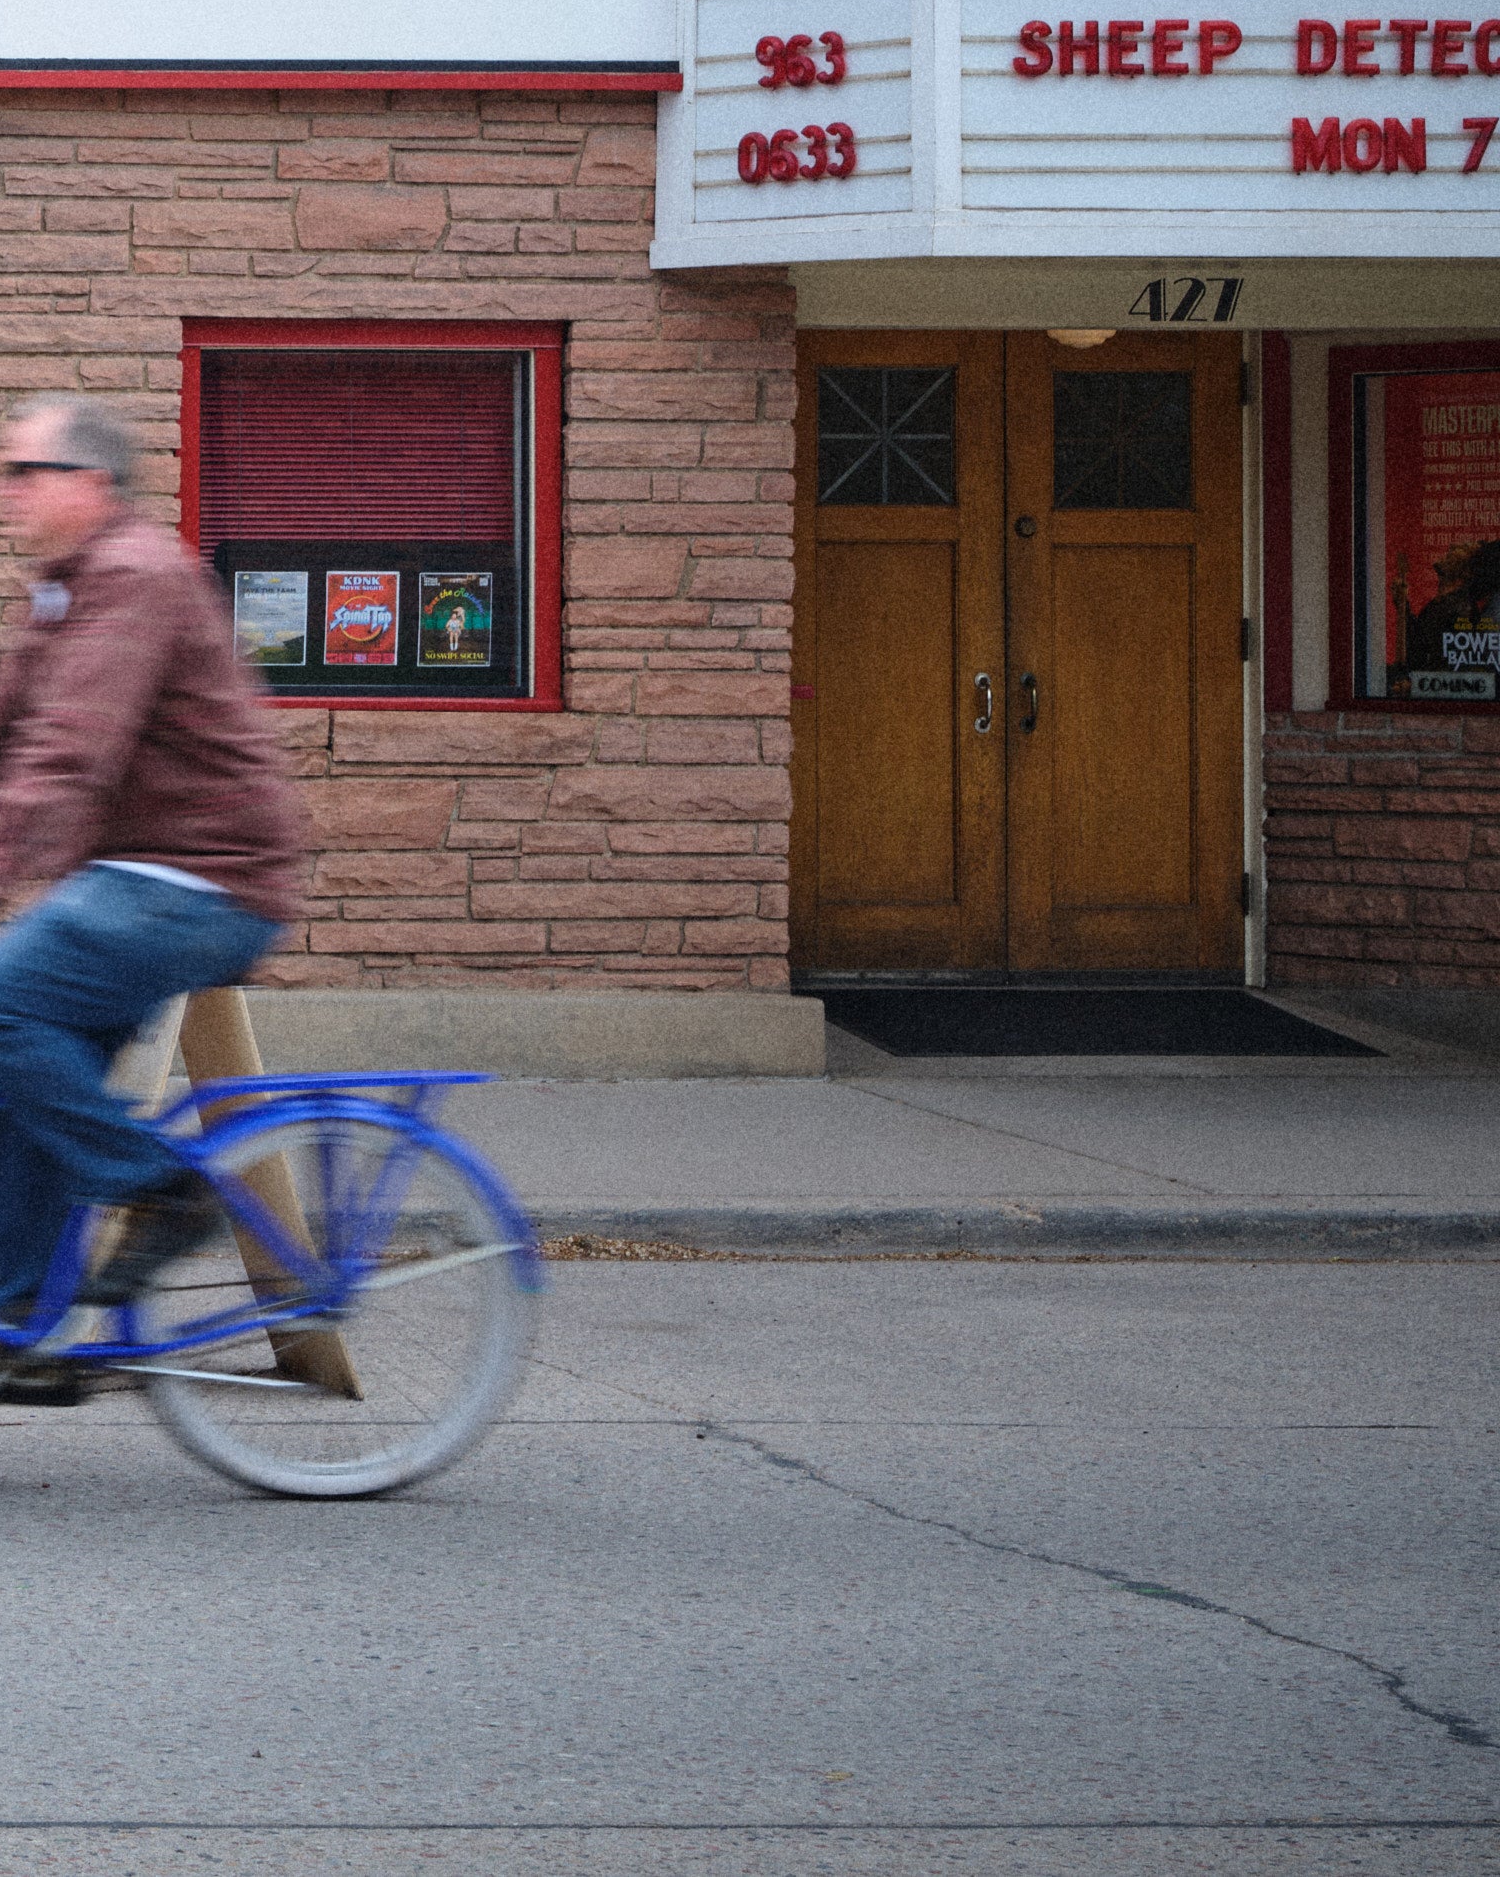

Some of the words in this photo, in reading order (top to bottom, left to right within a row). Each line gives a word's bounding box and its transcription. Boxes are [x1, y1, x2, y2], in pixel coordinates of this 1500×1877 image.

[755, 31, 847, 91] 963
[1012, 19, 1244, 77] SHEEP
[737, 122, 856, 185] 0633
[1291, 117, 1427, 175] MON
[1127, 277, 1245, 323] 427
[343, 576, 381, 586] KDNK
[1442, 631, 1500, 658] POWE
[1448, 650, 1500, 672] BALLA
[1418, 677, 1487, 694] COMING
